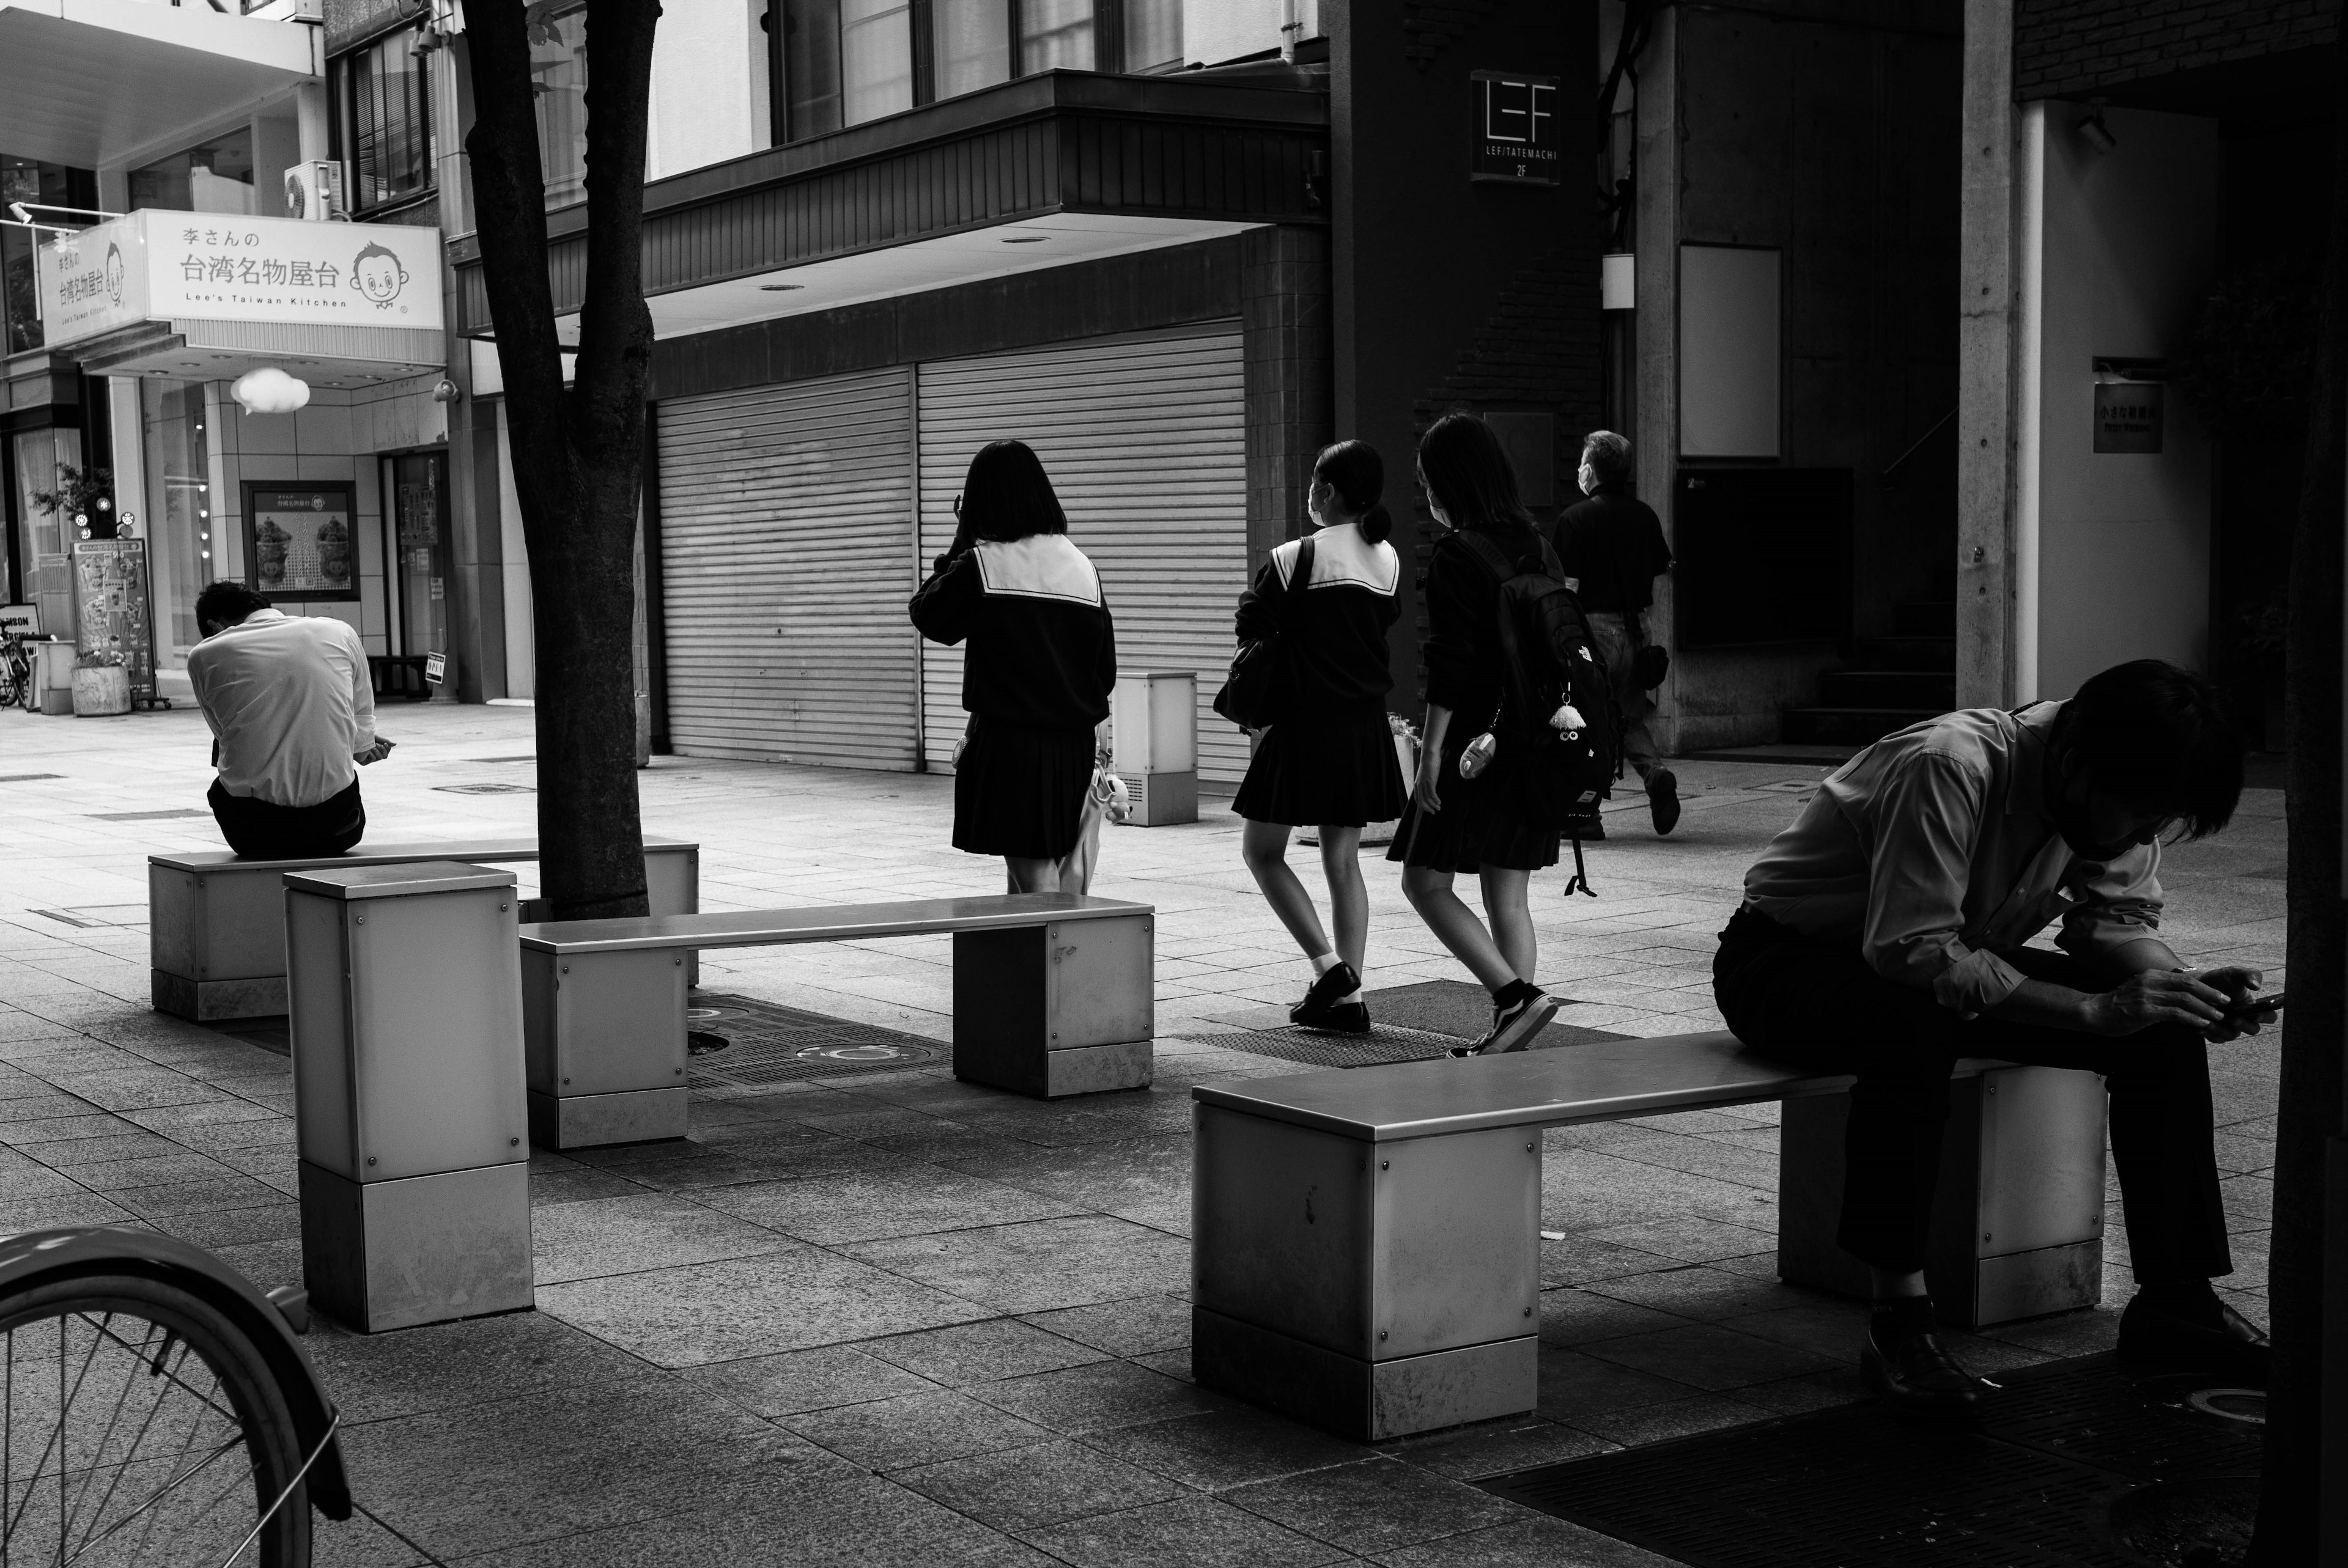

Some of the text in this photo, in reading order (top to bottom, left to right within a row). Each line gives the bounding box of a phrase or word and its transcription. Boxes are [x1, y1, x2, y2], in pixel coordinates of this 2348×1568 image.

[1486, 145, 1557, 160] LEF/TATEMACHI
[1517, 164, 1526, 177] 2F
[183, 227, 259, 246] 李さんの
[180, 254, 339, 288] 台湾名物屋台
[59, 268, 103, 307] 台湾名物屋台
[186, 293, 346, 307] Lee's Taiwan Kitchen
[428, 661, 442, 674] OPEN
